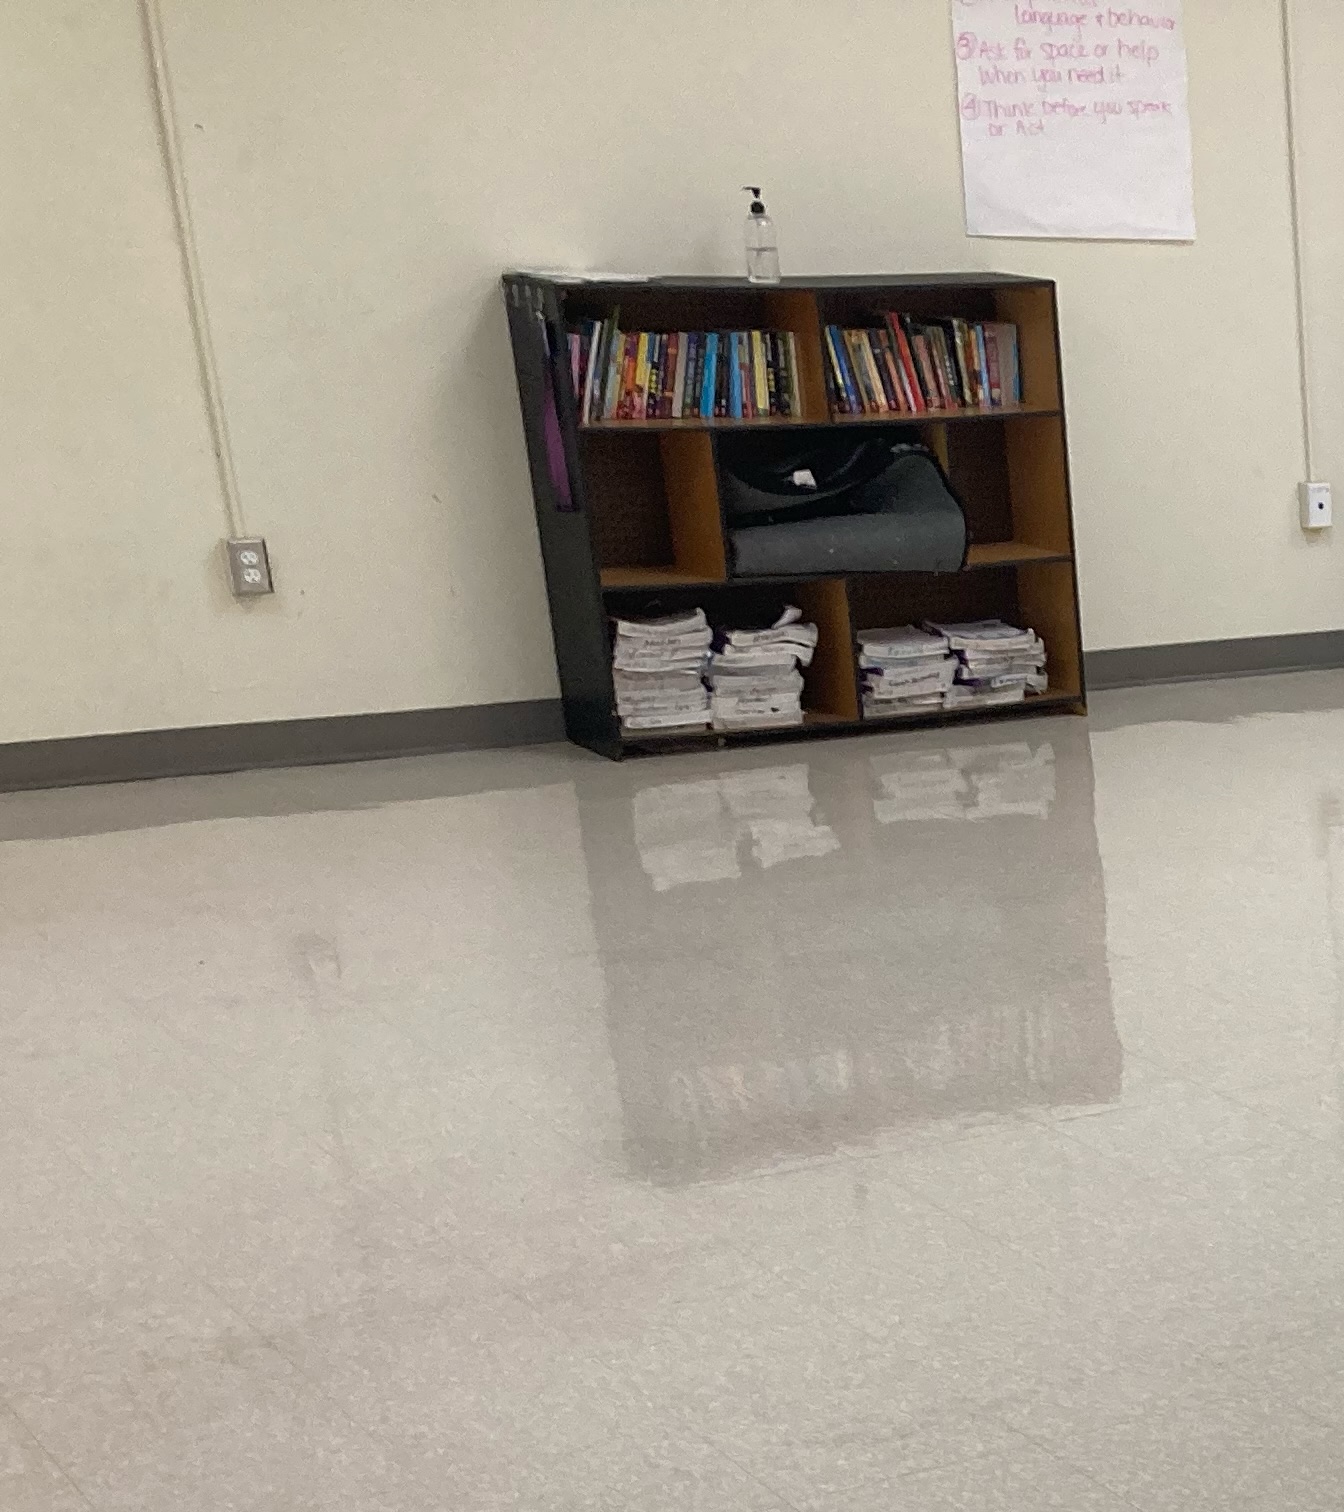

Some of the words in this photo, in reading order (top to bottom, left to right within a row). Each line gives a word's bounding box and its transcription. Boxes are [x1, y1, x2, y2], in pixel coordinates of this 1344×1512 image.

[1039, 42, 1088, 67] space
[1094, 43, 1108, 57] or
[1117, 38, 1159, 67] help
[1032, 67, 1062, 92] you
[1068, 66, 1104, 84] need
[1094, 101, 1122, 124] you
